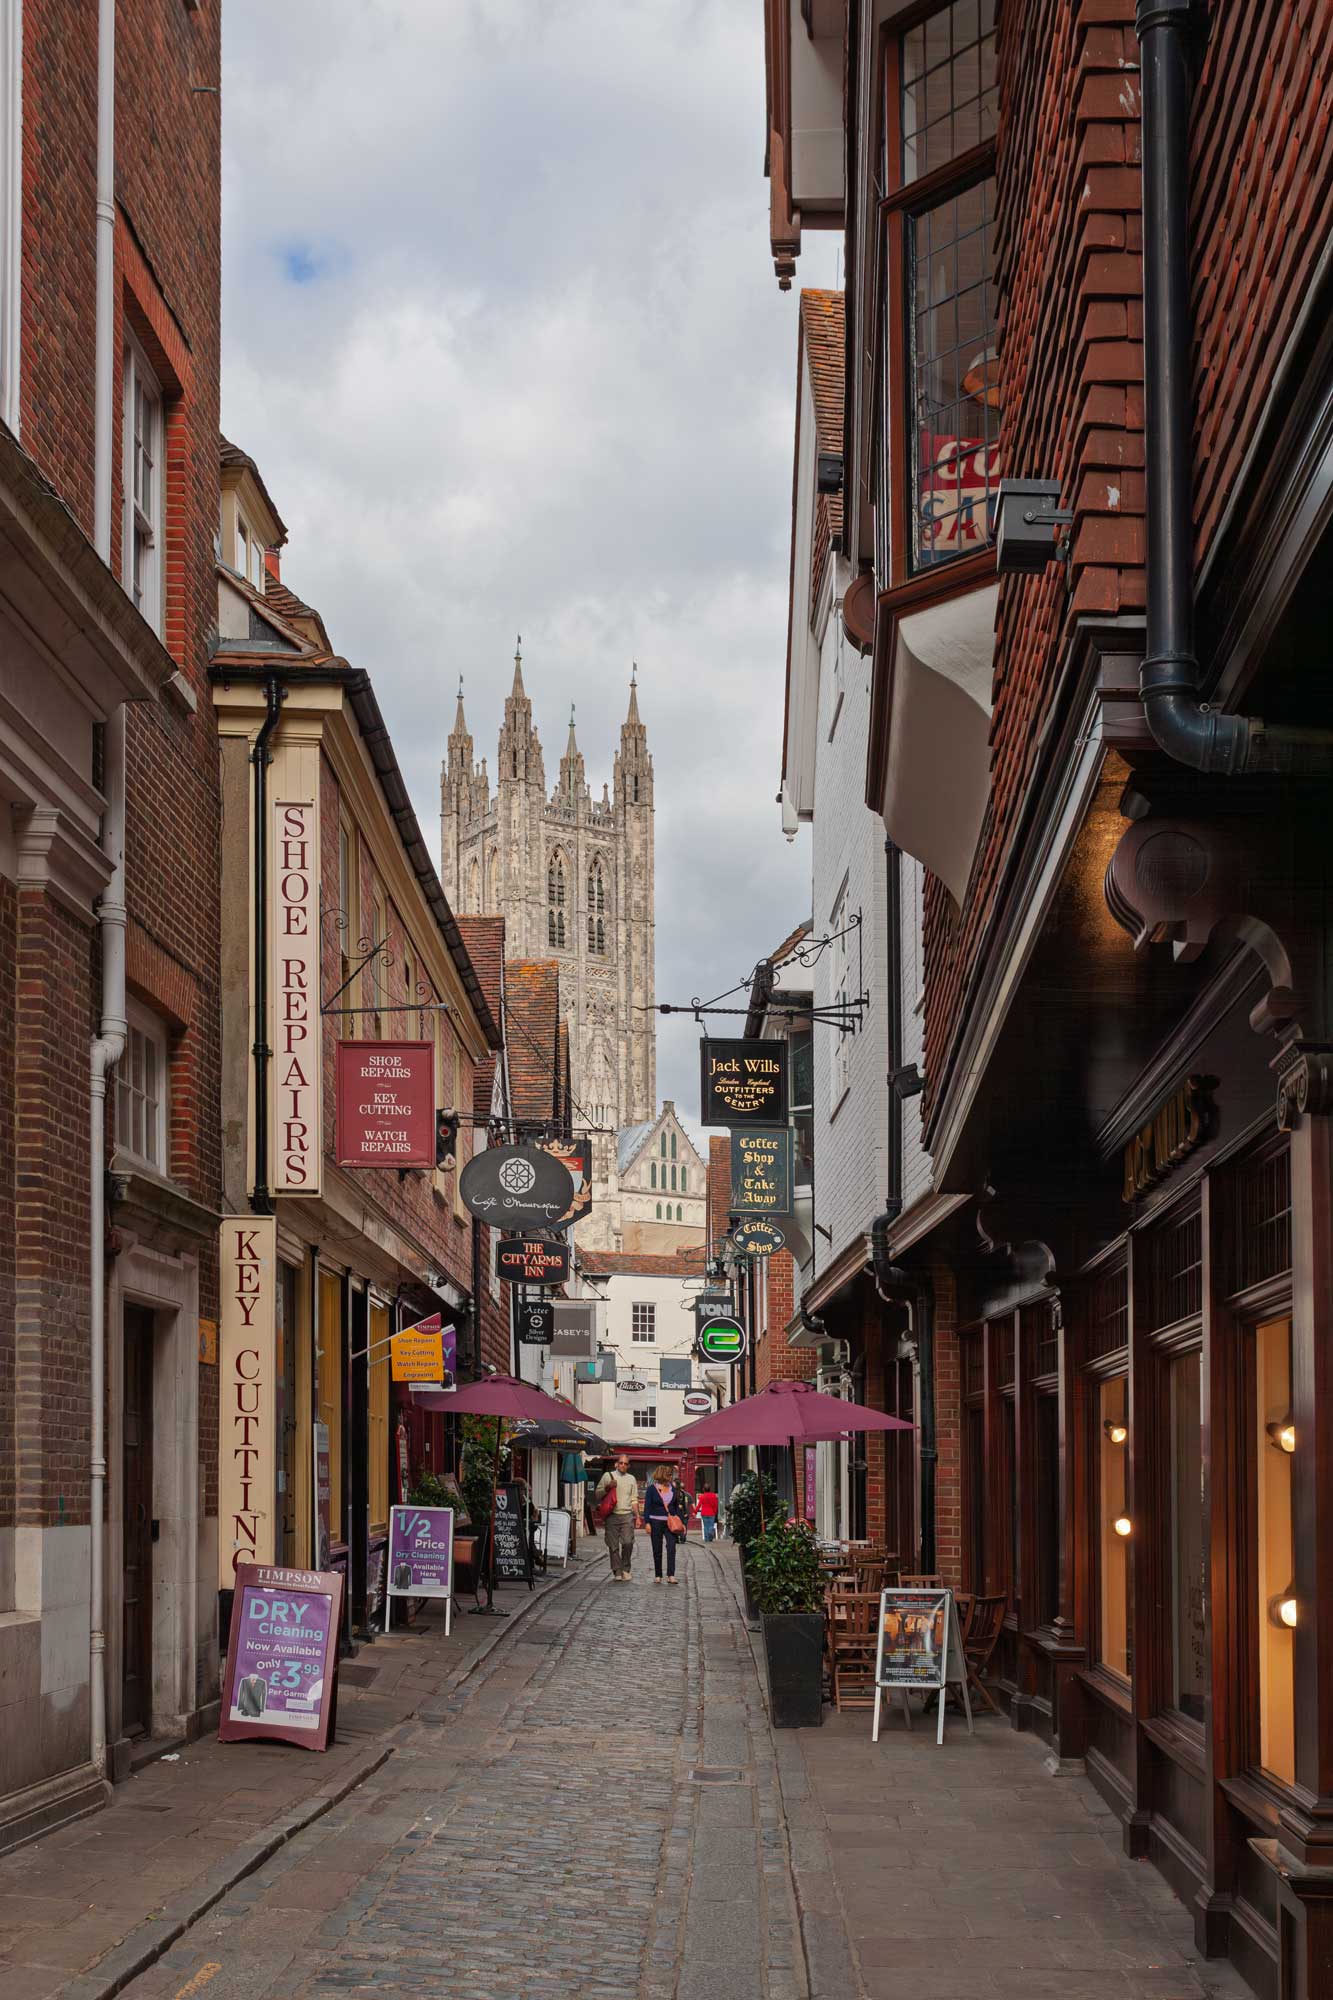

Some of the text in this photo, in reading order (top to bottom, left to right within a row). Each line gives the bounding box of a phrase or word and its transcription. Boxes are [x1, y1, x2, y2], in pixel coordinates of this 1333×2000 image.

[280, 807, 310, 1185] SHOE REPAIRS
[369, 1056, 402, 1067] SHOE
[709, 1058, 780, 1076] Jack Wills
[360, 1067, 411, 1078] REPAIRS
[714, 1085, 775, 1094] OUTFITTERS
[374, 1093, 397, 1104] KEY
[723, 1096, 766, 1109] GENTRY
[359, 1104, 412, 1115] CUTTING
[364, 1130, 407, 1142] WATCH
[361, 1141, 411, 1153] REPAIRS
[740, 1137, 779, 1150] Coffee
[743, 1151, 775, 1166] Shop
[754, 1165, 765, 1177] &
[744, 1179, 776, 1190] Take
[742, 1191, 777, 1207] Away
[743, 1222, 776, 1236] Coffee
[523, 1242, 545, 1254] THE
[746, 1240, 773, 1255] Shop
[501, 1253, 563, 1267] CITY ARMS
[524, 1266, 545, 1278] INN
[234, 1231, 260, 1326] KEY
[524, 1306, 550, 1314] Aztec
[699, 1304, 733, 1317] TONI
[396, 1512, 432, 1538] 1/2
[415, 1539, 446, 1550] Price
[411, 1552, 446, 1561] Cleaning
[257, 1568, 321, 1585] TIMPSON
[249, 1599, 309, 1624] DRY
[259, 1622, 324, 1641] Cleaning
[246, 1641, 322, 1657] Now Available
[256, 1659, 281, 1670] Only
[268, 1688, 308, 1698] Per Garm
